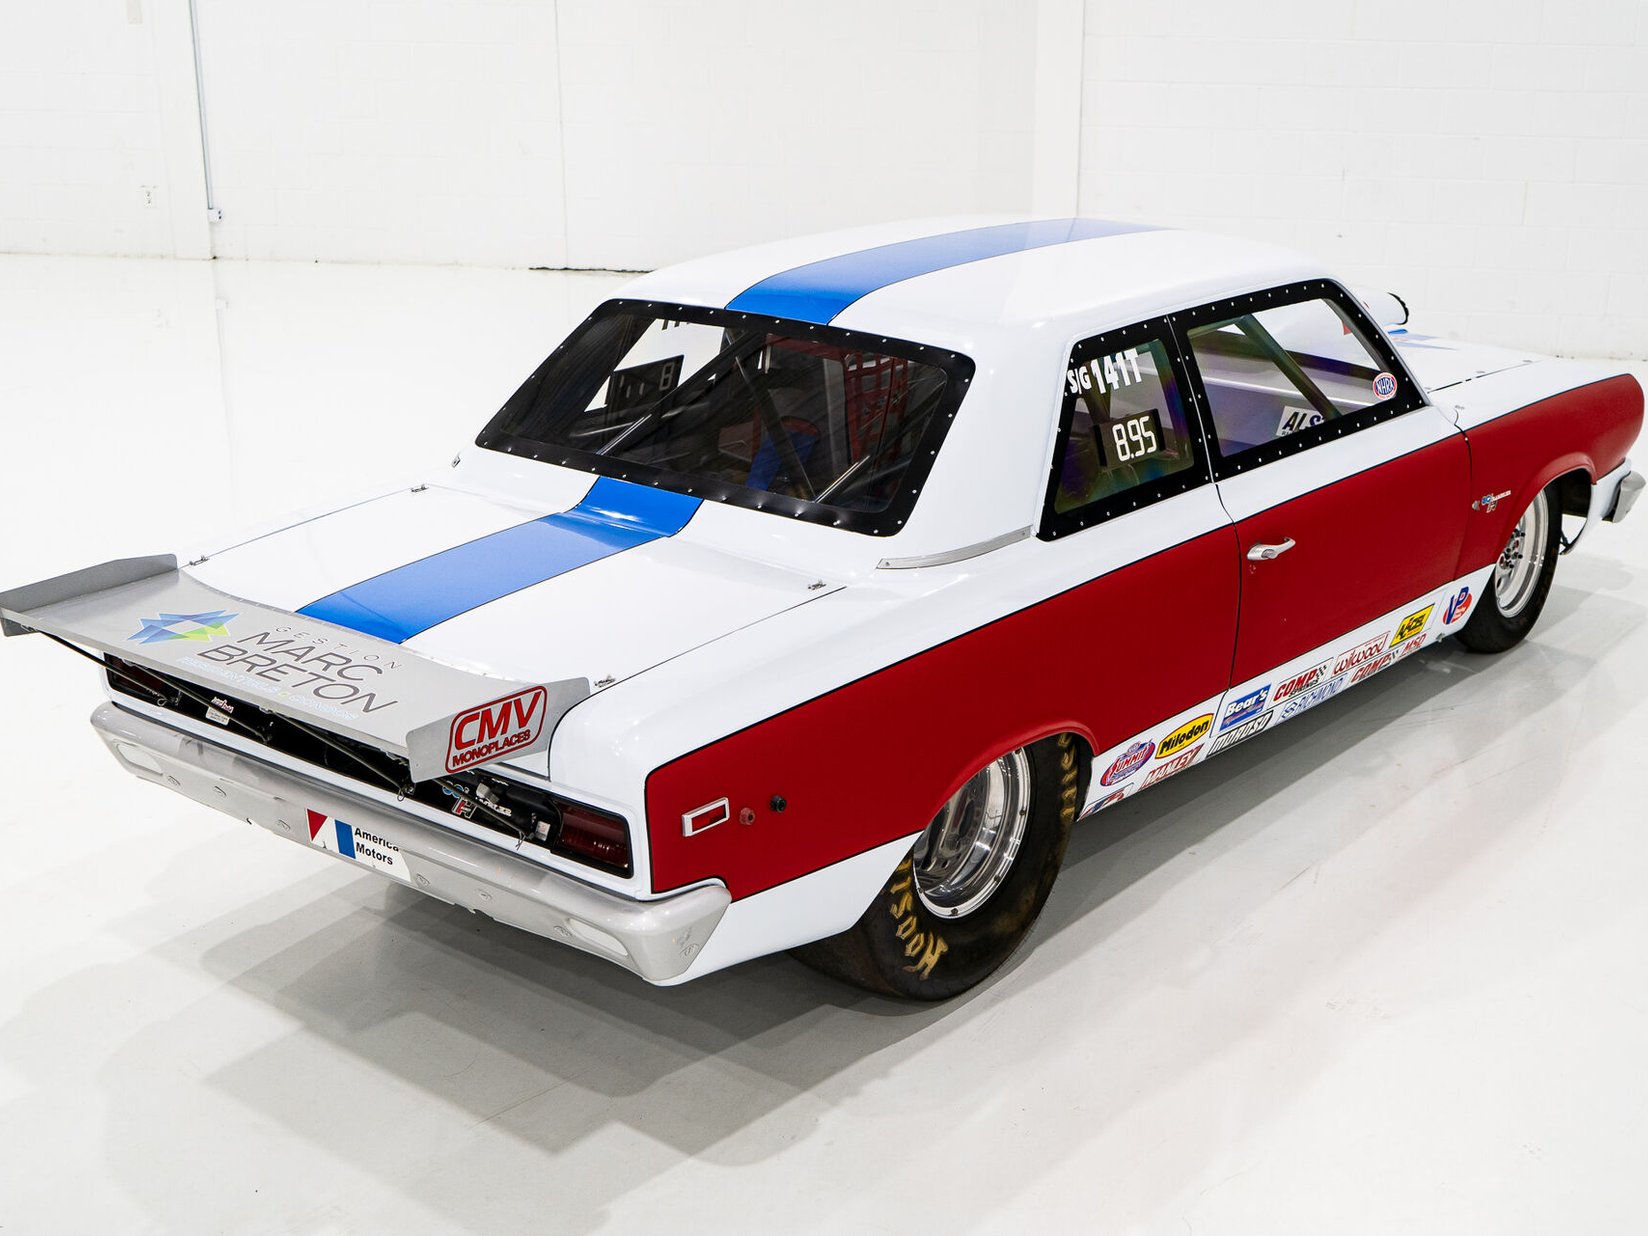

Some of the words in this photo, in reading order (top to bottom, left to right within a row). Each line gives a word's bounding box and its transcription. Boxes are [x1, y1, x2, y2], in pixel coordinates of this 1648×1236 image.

[1090, 348, 1142, 394] 141T
[1376, 377, 1395, 395] NHRA
[1112, 416, 1157, 461] 8.95
[1445, 586, 1470, 625] VP
[237, 631, 383, 681] MARC
[275, 626, 402, 670] GESTION
[197, 644, 398, 713] BRETON
[1273, 668, 1318, 702] COMP
[455, 691, 543, 750] CMV
[1225, 690, 1268, 717] Bear's
[452, 729, 531, 768] MONOPLACES
[1159, 721, 1209, 755] Milodon
[1110, 746, 1148, 776] SUMMIT
[356, 842, 394, 866] Motors
